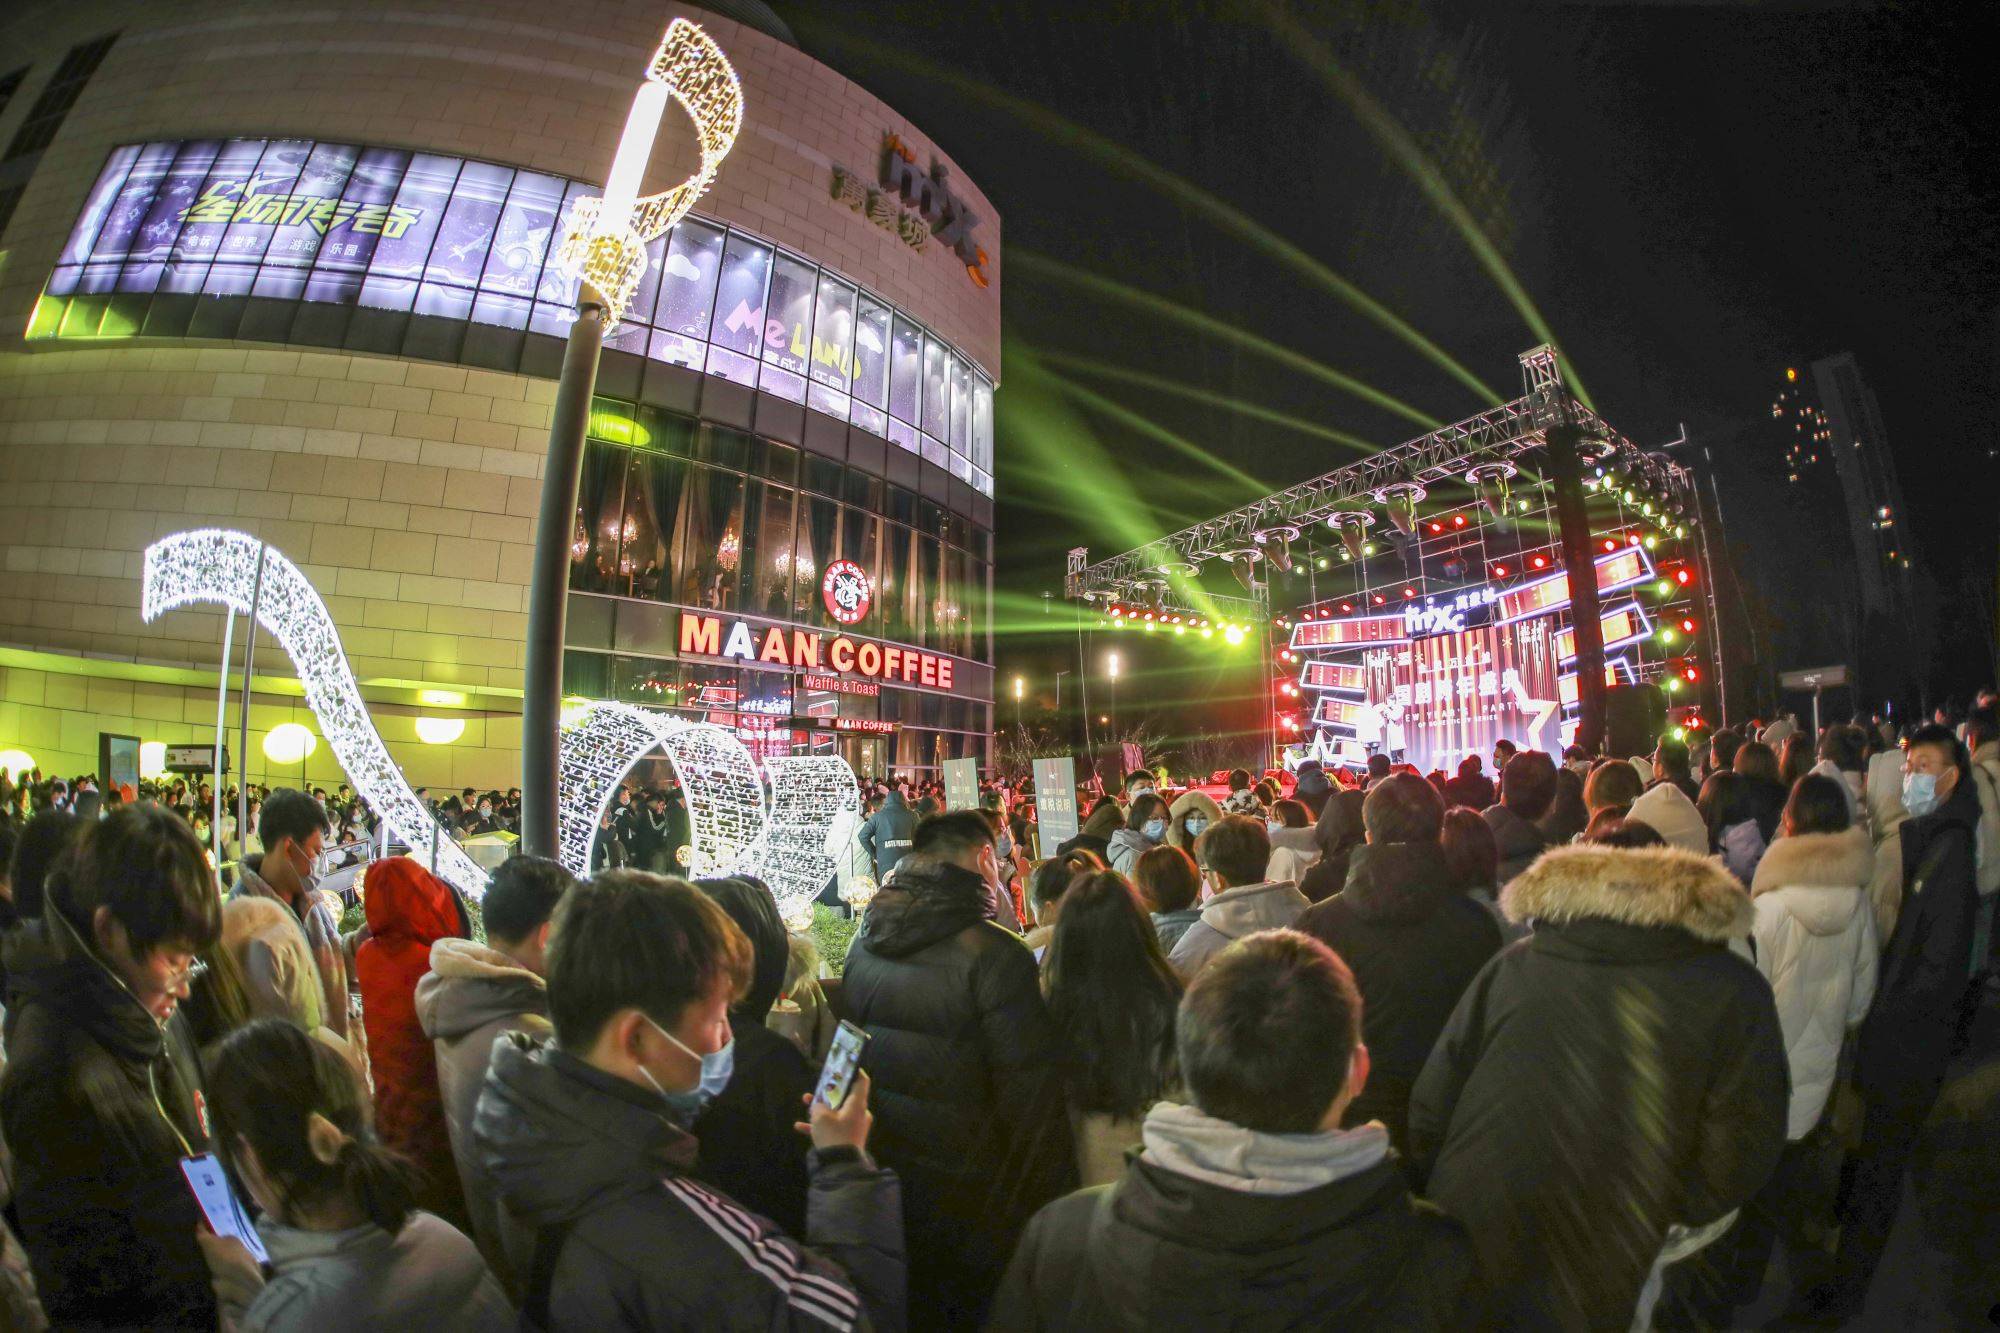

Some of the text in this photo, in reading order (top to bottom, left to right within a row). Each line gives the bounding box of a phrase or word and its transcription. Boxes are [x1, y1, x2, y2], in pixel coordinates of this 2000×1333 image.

[178, 171, 424, 240] 星际传奇
[232, 236, 257, 247] 世界
[289, 239, 316, 252] 游戏
[330, 243, 359, 256] 乐园
[680, 612, 953, 689] MAAN COFFEE
[805, 674, 879, 695] Waffle & Toast
[836, 719, 894, 733] MAAN COFFEE
